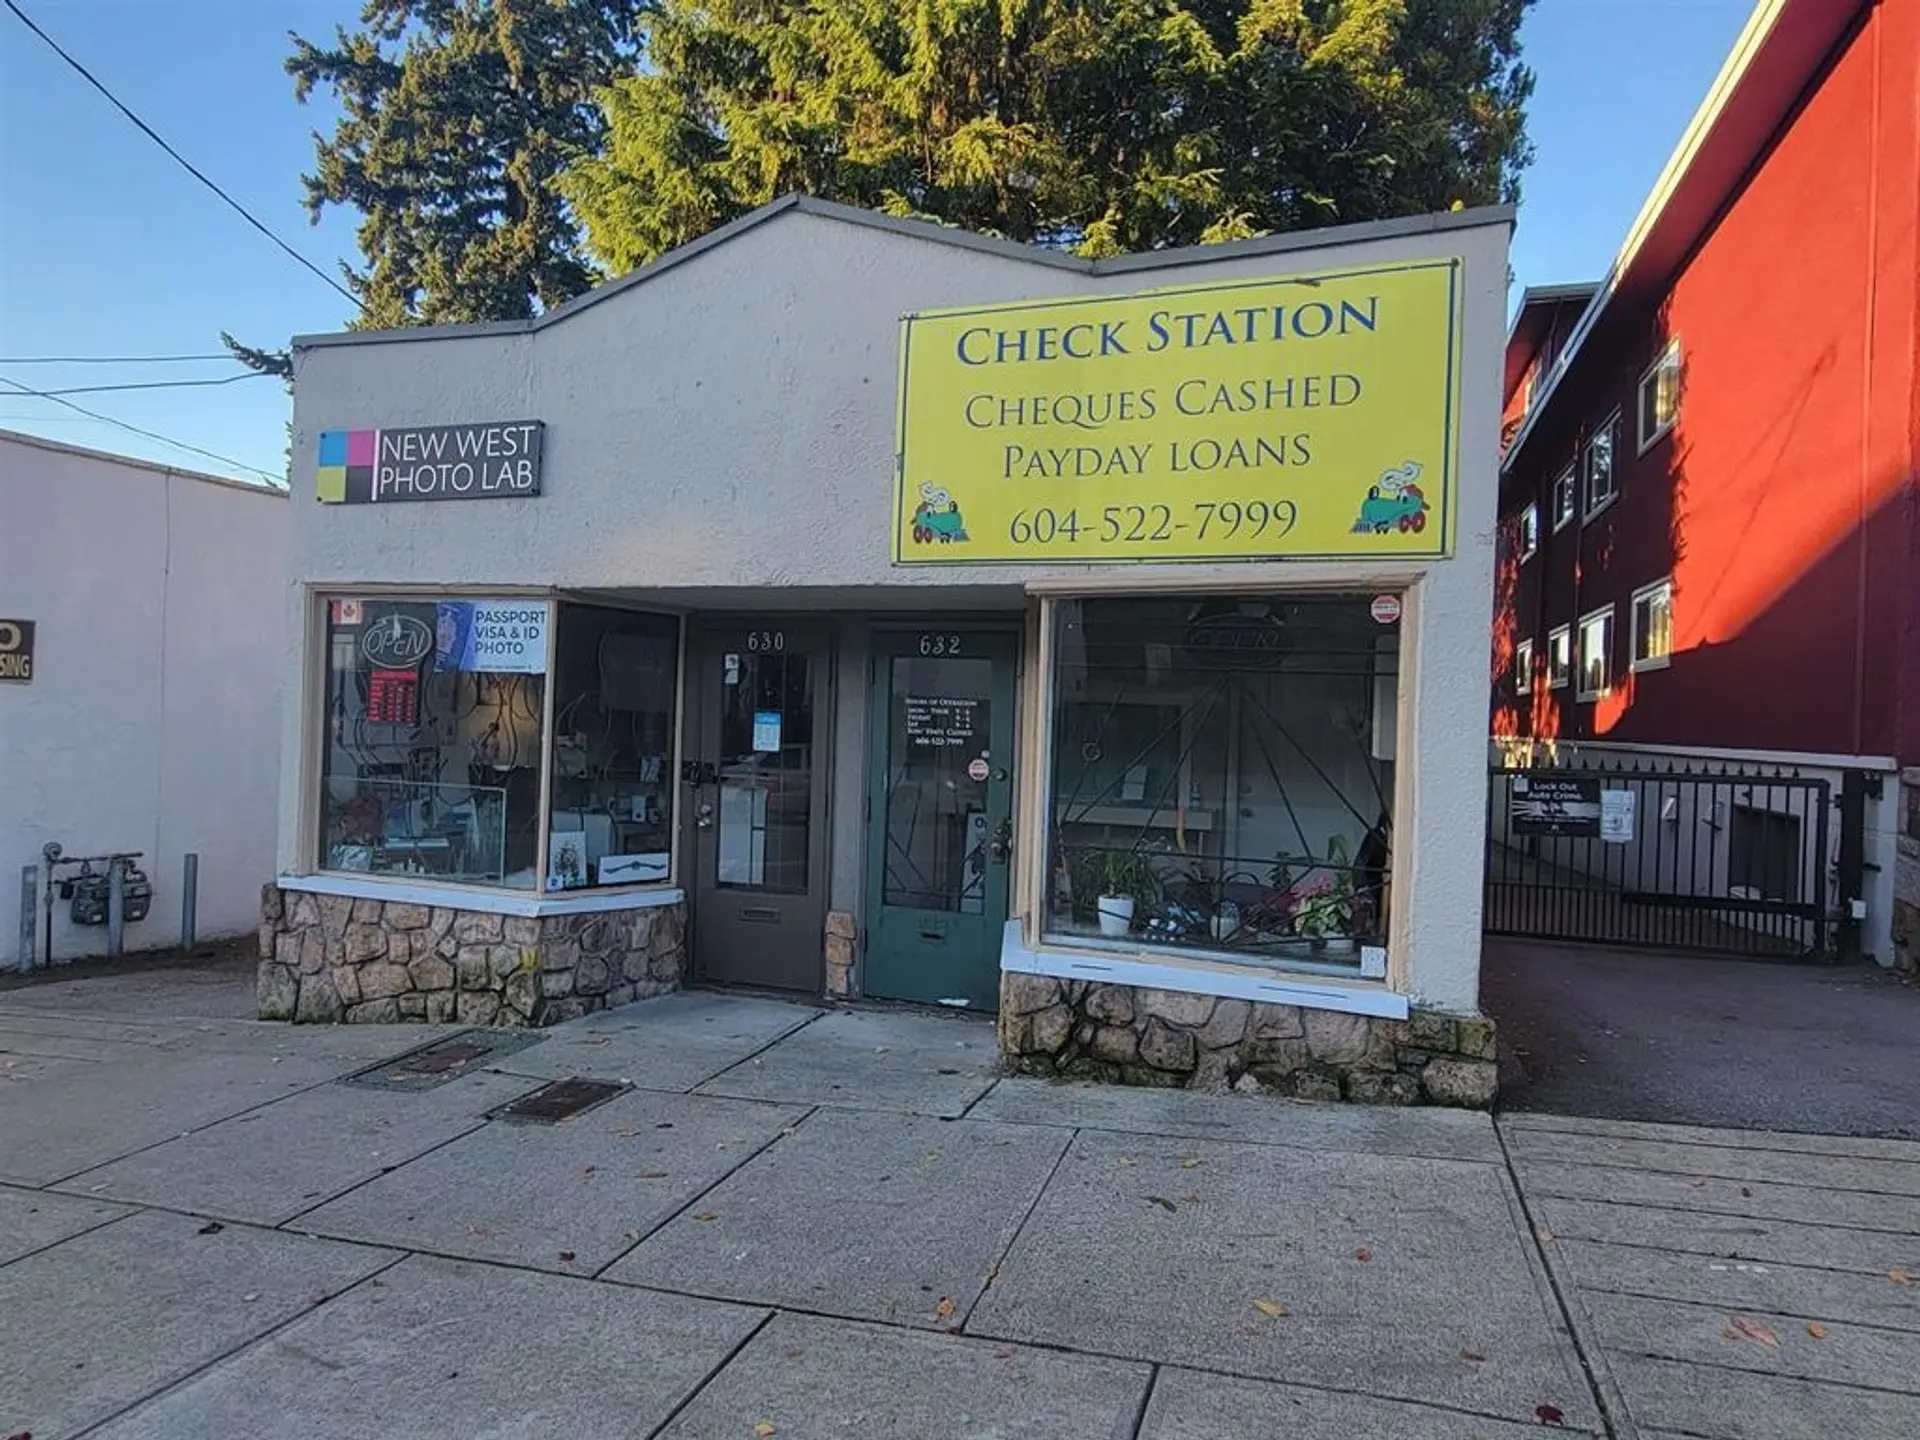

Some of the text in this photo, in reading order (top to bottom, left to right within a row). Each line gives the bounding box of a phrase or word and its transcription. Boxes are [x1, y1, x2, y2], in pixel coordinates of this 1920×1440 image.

[956, 296, 1380, 366] CHECK STATION
[965, 373, 1362, 431] CHEQUES CASHED
[382, 425, 537, 462] NEW WEST
[1003, 434, 1312, 480] PAYDAY LOANS
[379, 460, 533, 494] PHOTO LAB
[1009, 499, 1298, 545] 604-522-7999
[475, 610, 546, 625] PASSPORT
[366, 629, 425, 656] OPEN
[475, 626, 540, 639] VISA & ID
[748, 632, 785, 651] 630
[475, 641, 525, 655] PHOTO
[920, 635, 962, 655] 632
[1528, 791, 1551, 800] Auto
[1533, 782, 1578, 791] Lock Out
